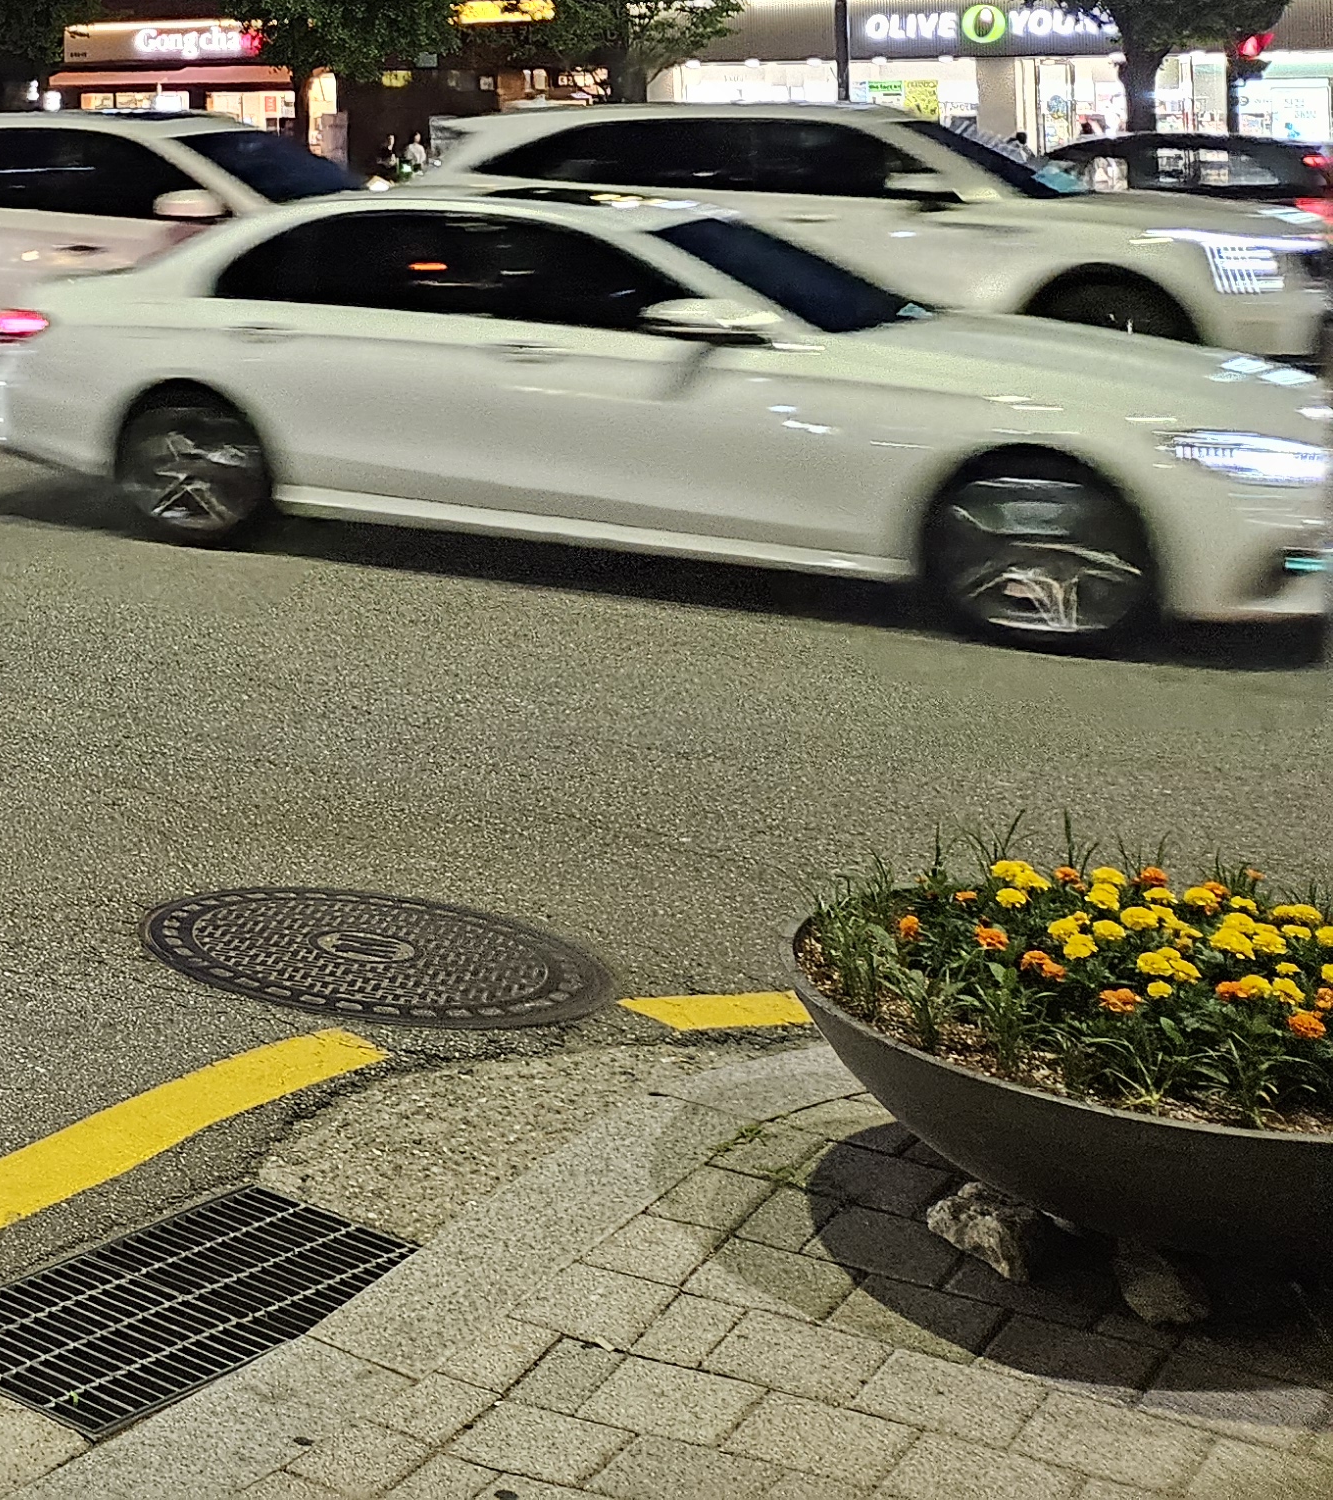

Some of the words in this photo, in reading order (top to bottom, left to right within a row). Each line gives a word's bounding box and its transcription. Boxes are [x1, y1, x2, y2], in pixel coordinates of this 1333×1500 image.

[865, 11, 957, 39] OLIVE
[135, 28, 199, 59] Gong
[199, 27, 241, 51] cha
